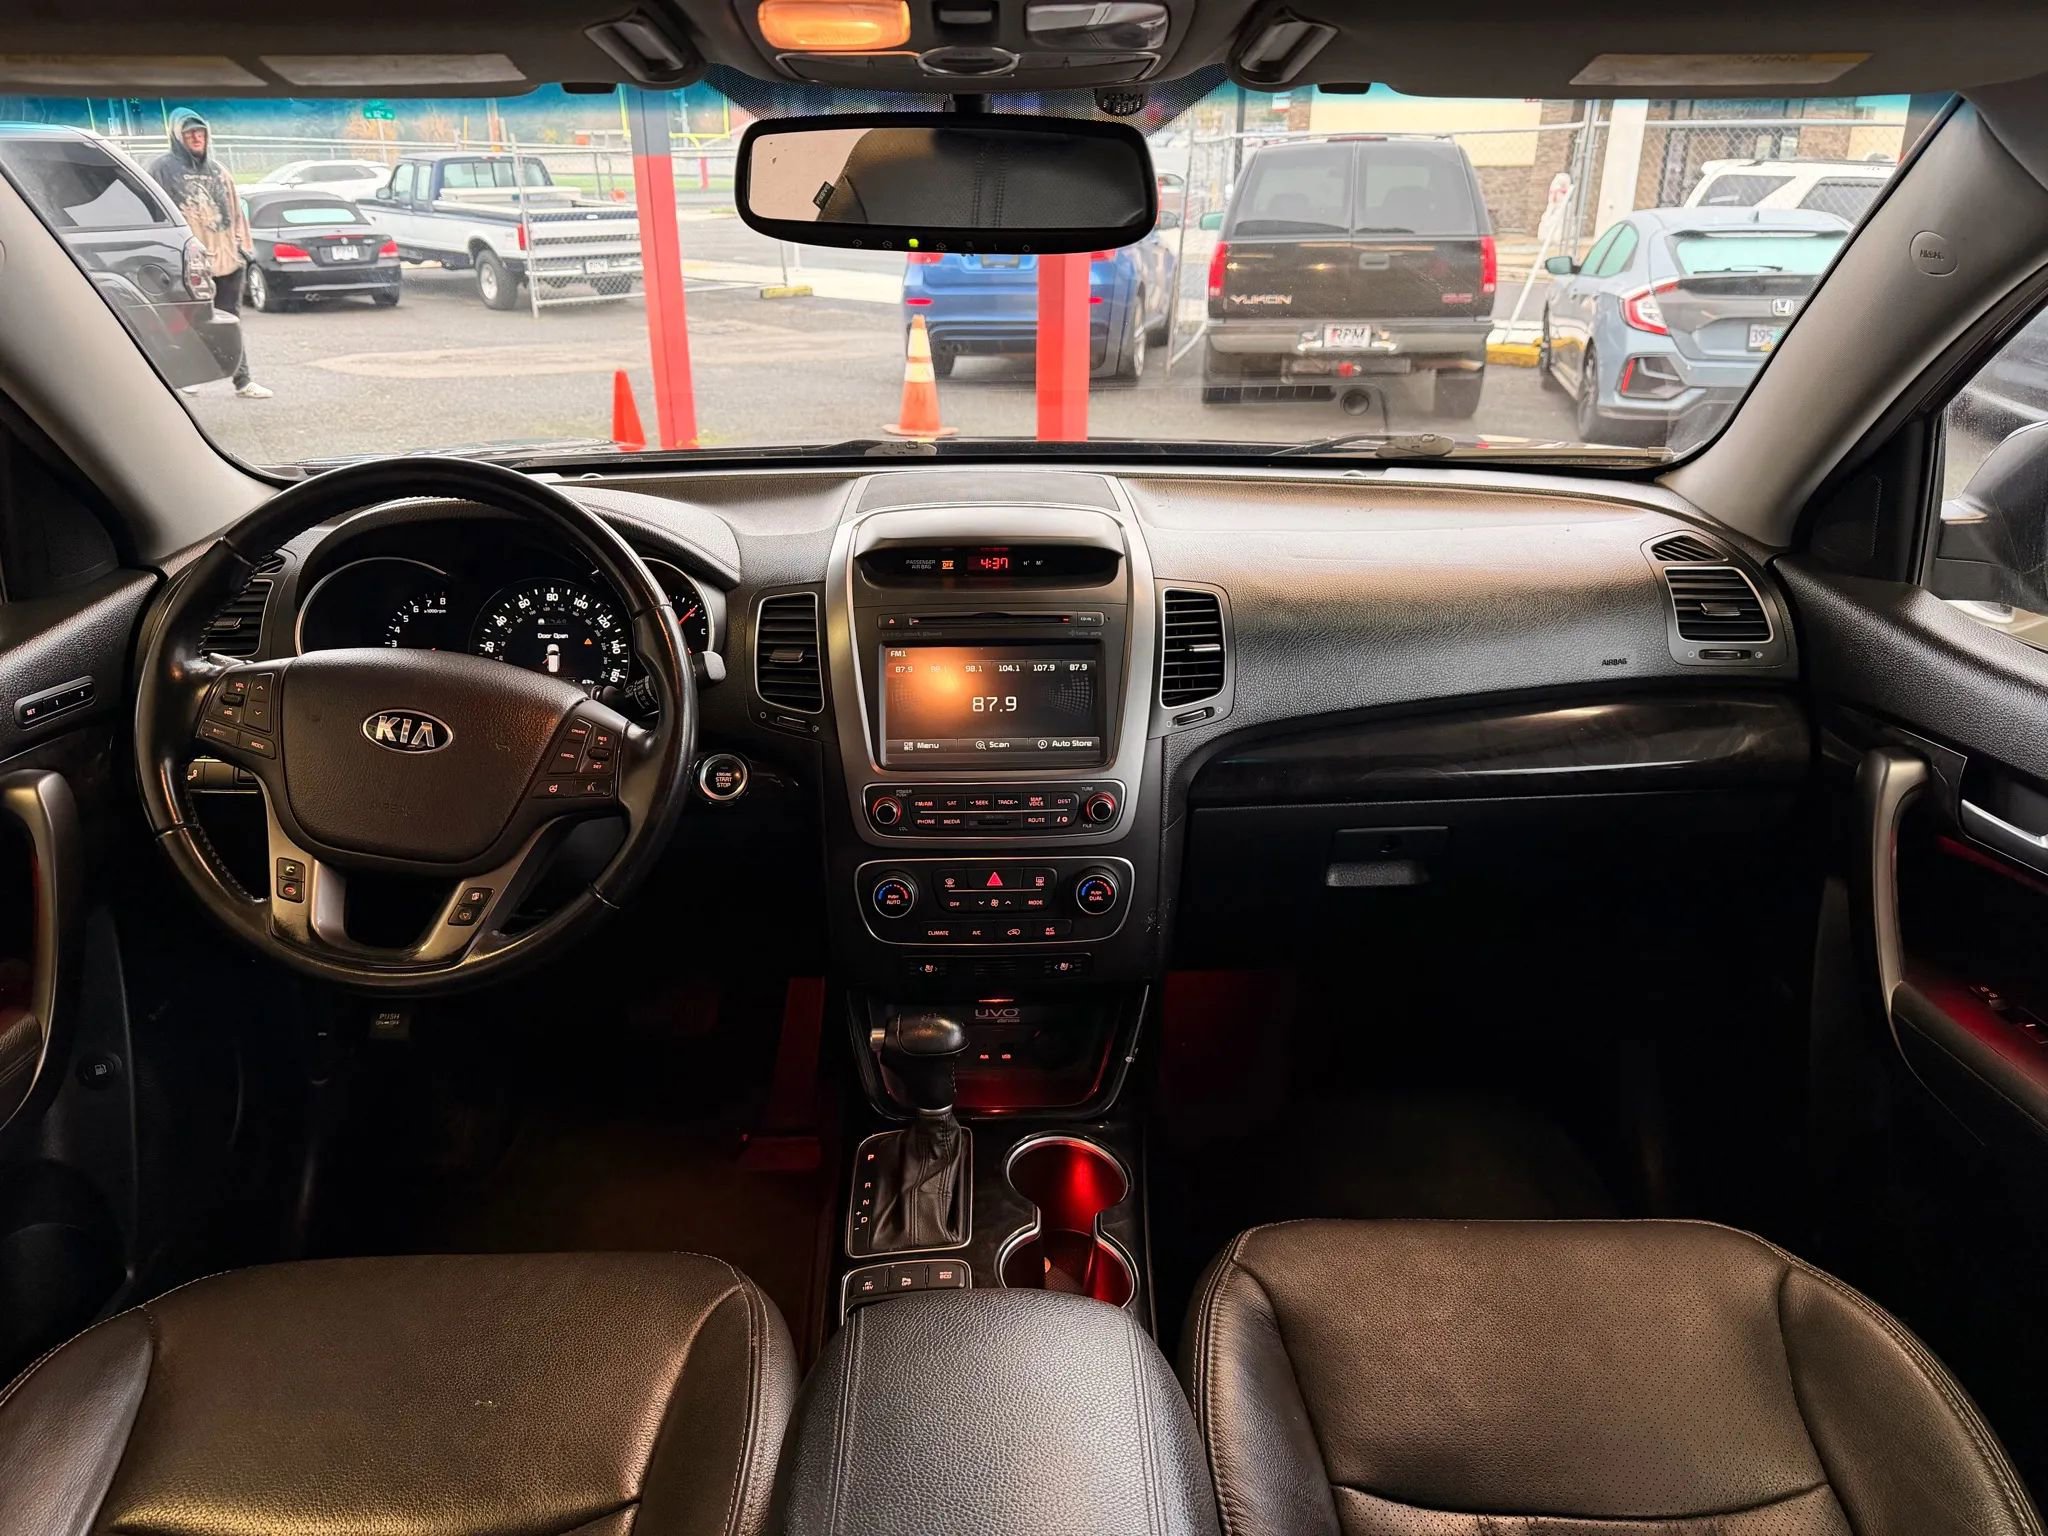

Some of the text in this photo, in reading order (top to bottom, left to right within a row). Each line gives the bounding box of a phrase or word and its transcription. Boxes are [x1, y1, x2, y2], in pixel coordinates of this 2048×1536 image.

[1230, 294, 1292, 305] YUKON
[980, 558, 1008, 570] 4:37
[440, 597, 446, 605] 8
[518, 598, 530, 608] 60
[546, 593, 558, 602] 80
[574, 598, 588, 609] 100
[496, 616, 507, 627] 40
[597, 614, 610, 628] 120
[485, 642, 494, 652] 20
[611, 640, 620, 654] 140
[610, 668, 620, 682] 160
[972, 696, 1018, 712] 87.9
[376, 716, 436, 748] KIA
[251, 741, 264, 750] MODE
[975, 1008, 1020, 1018] UVO
